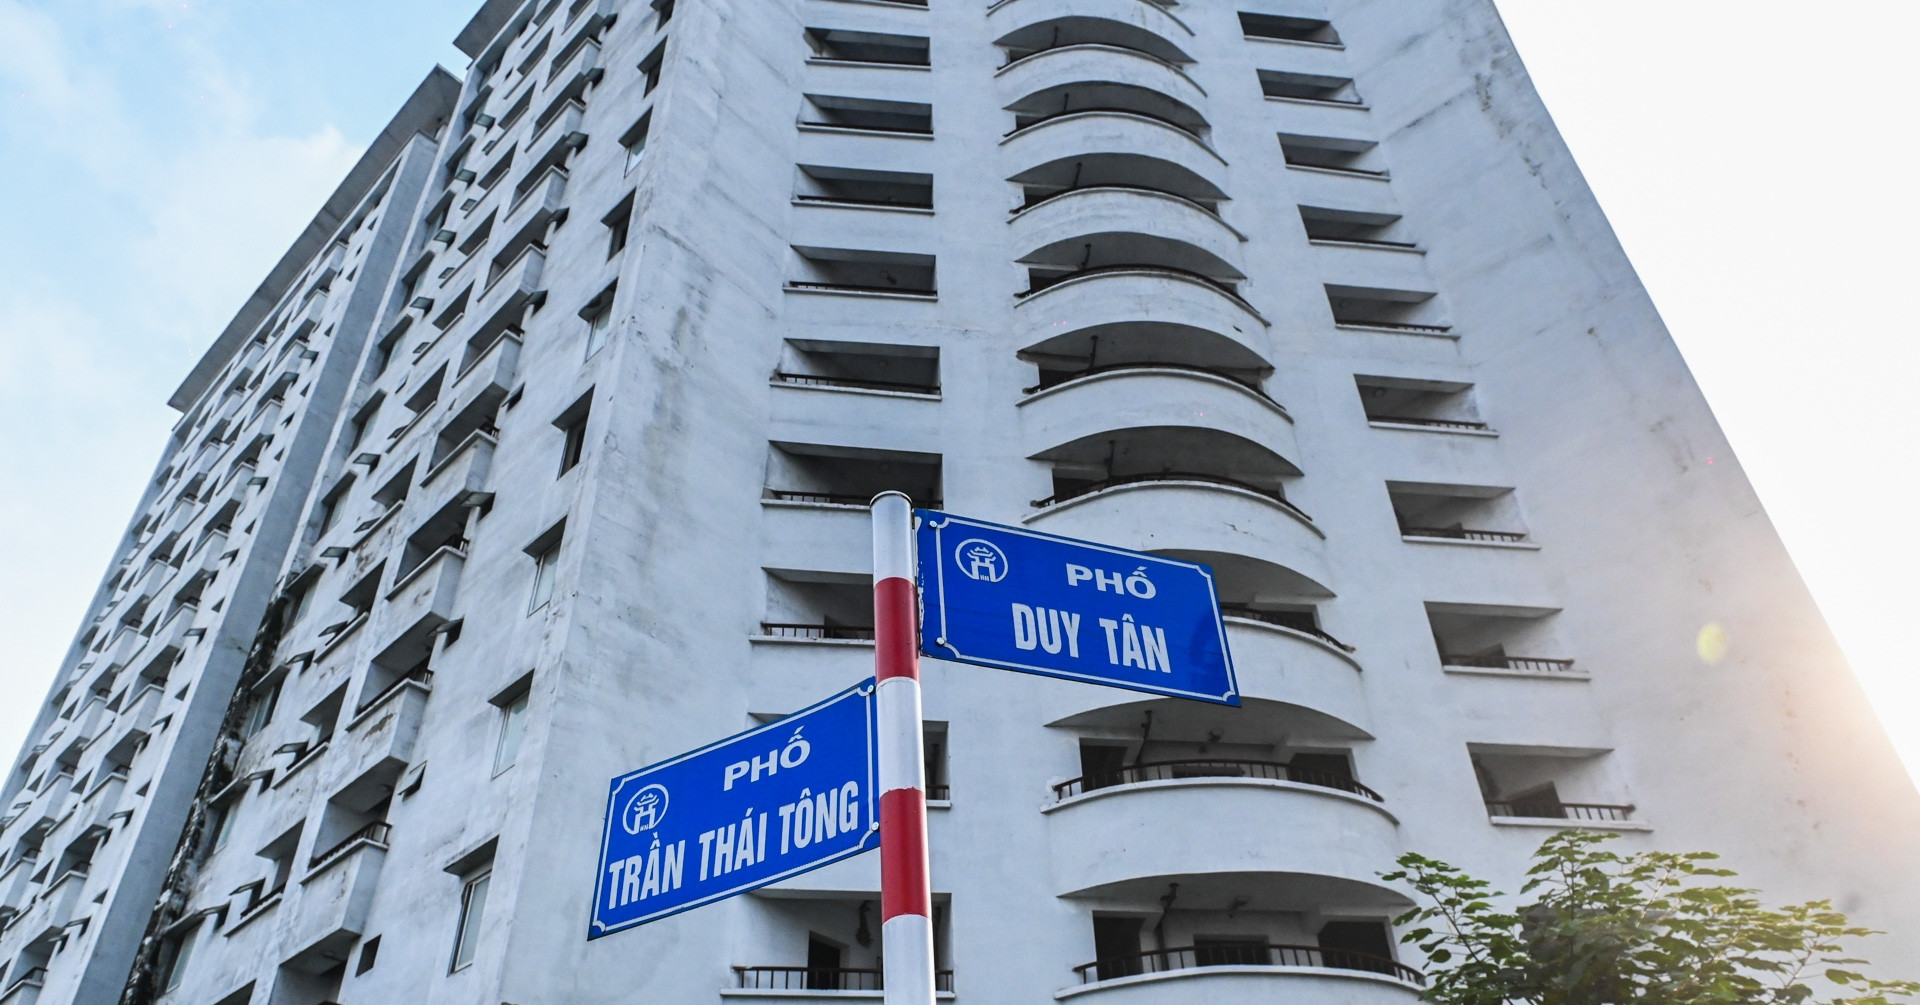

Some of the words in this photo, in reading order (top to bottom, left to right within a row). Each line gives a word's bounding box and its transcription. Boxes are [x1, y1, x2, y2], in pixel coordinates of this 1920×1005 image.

[1066, 564, 1157, 600] PHỐ
[1012, 603, 1081, 658] DUY
[1099, 614, 1171, 674] TÂN
[723, 726, 811, 791] PHỐ
[609, 832, 686, 910] TRẦN
[699, 808, 768, 882] THÁI
[779, 781, 859, 855] TÔNG
